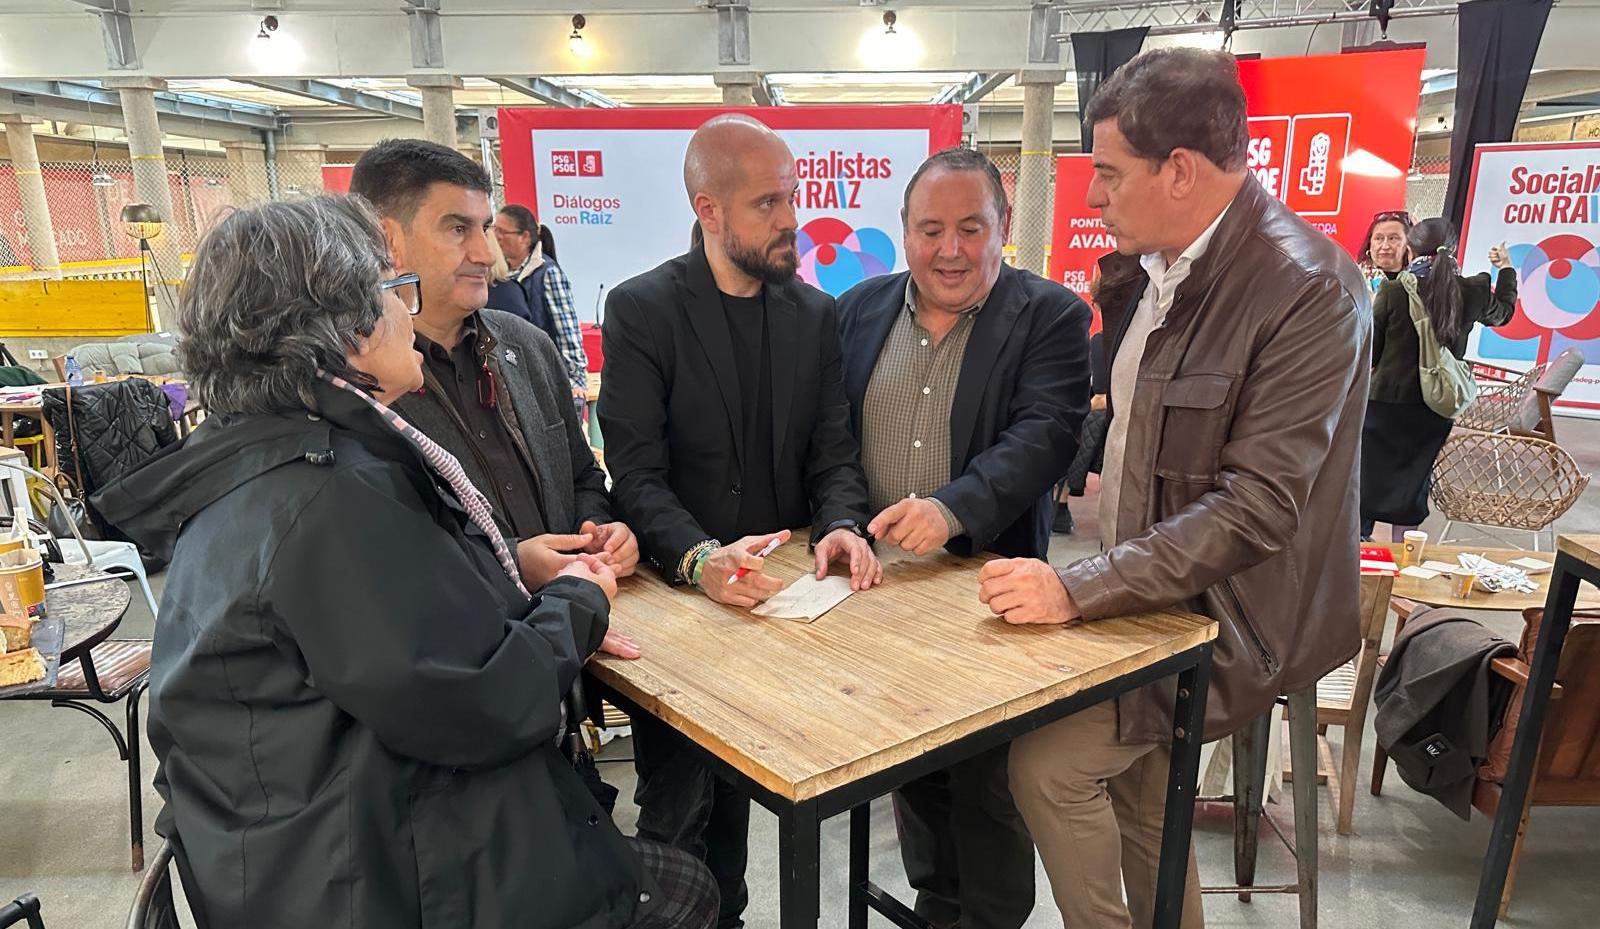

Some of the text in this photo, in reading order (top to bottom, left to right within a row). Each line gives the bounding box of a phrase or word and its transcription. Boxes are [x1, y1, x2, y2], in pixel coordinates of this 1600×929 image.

[553, 155, 570, 164] PSG
[1247, 137, 1272, 167] SG
[553, 163, 576, 173] PSOE
[795, 150, 892, 180] cialistas
[553, 194, 621, 212] Diálogos
[555, 215, 578, 225] con
[1504, 203, 1546, 224] CON
[1063, 270, 1086, 282] PSG
